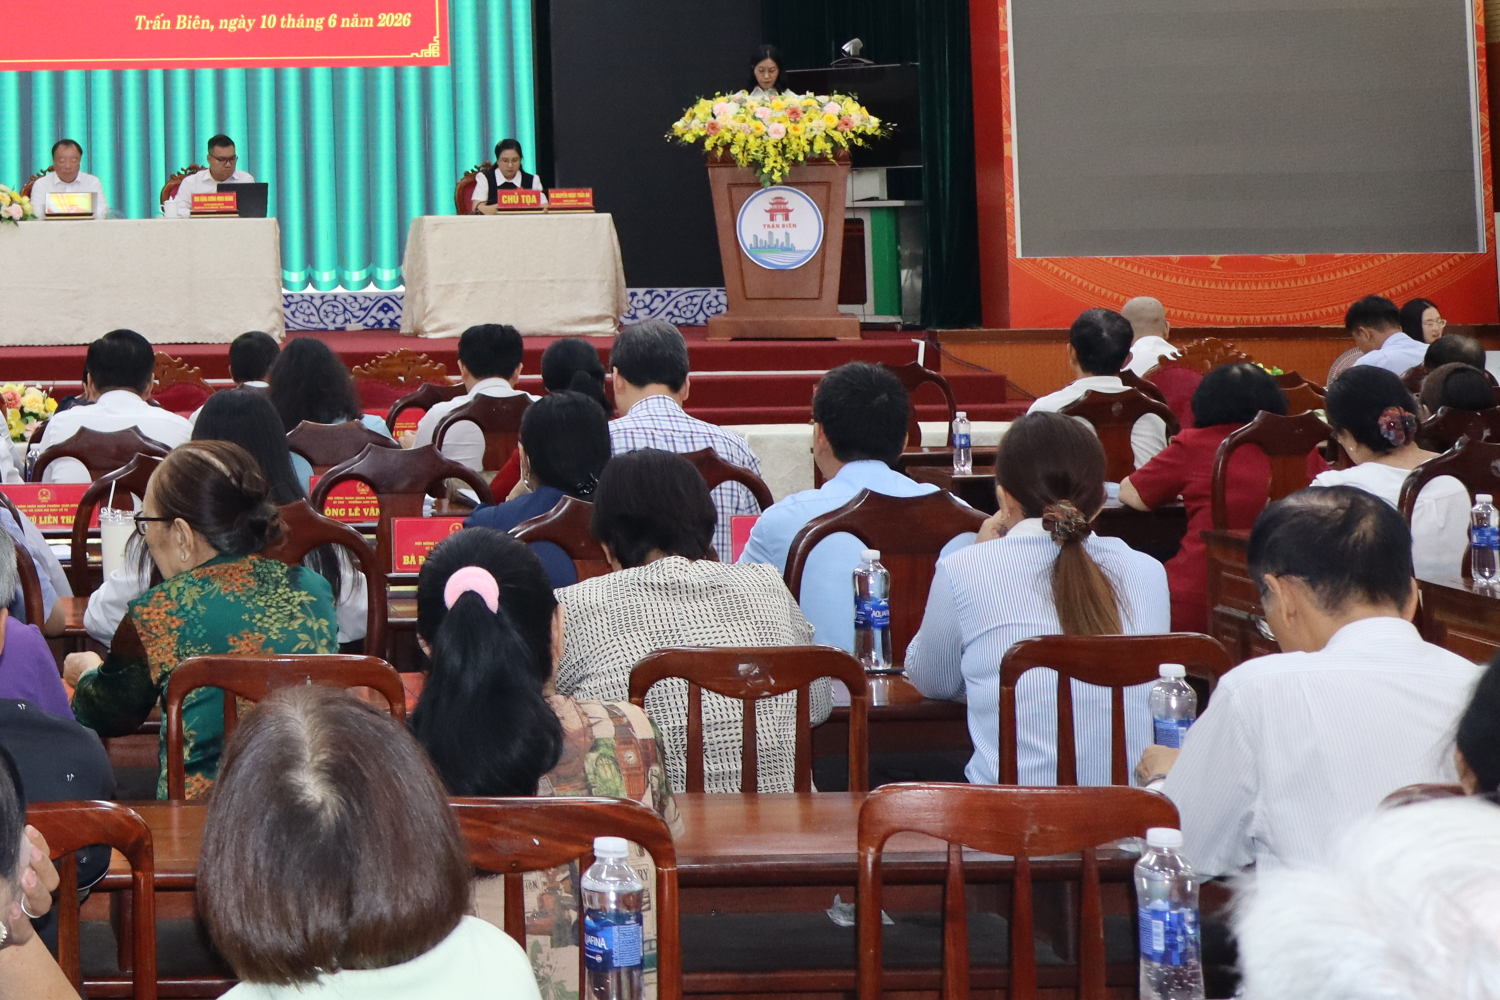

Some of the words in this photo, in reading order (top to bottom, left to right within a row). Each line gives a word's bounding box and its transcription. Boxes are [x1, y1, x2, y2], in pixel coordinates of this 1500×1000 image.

[135, 13, 171, 31] Trấn
[175, 15, 215, 32] Biên,
[218, 16, 256, 32] ngày
[259, 14, 277, 29] 10
[280, 14, 325, 31] tháng
[327, 14, 338, 28] 6
[340, 14, 374, 28] năm
[377, 13, 412, 27] 2026
[501, 192, 519, 204] CHỦ
[521, 194, 538, 205] TỌA
[324, 507, 346, 517] ÔNG
[348, 506, 361, 516] LÊ
[60, 515, 75, 524] THA
[402, 553, 416, 565] BÀ
